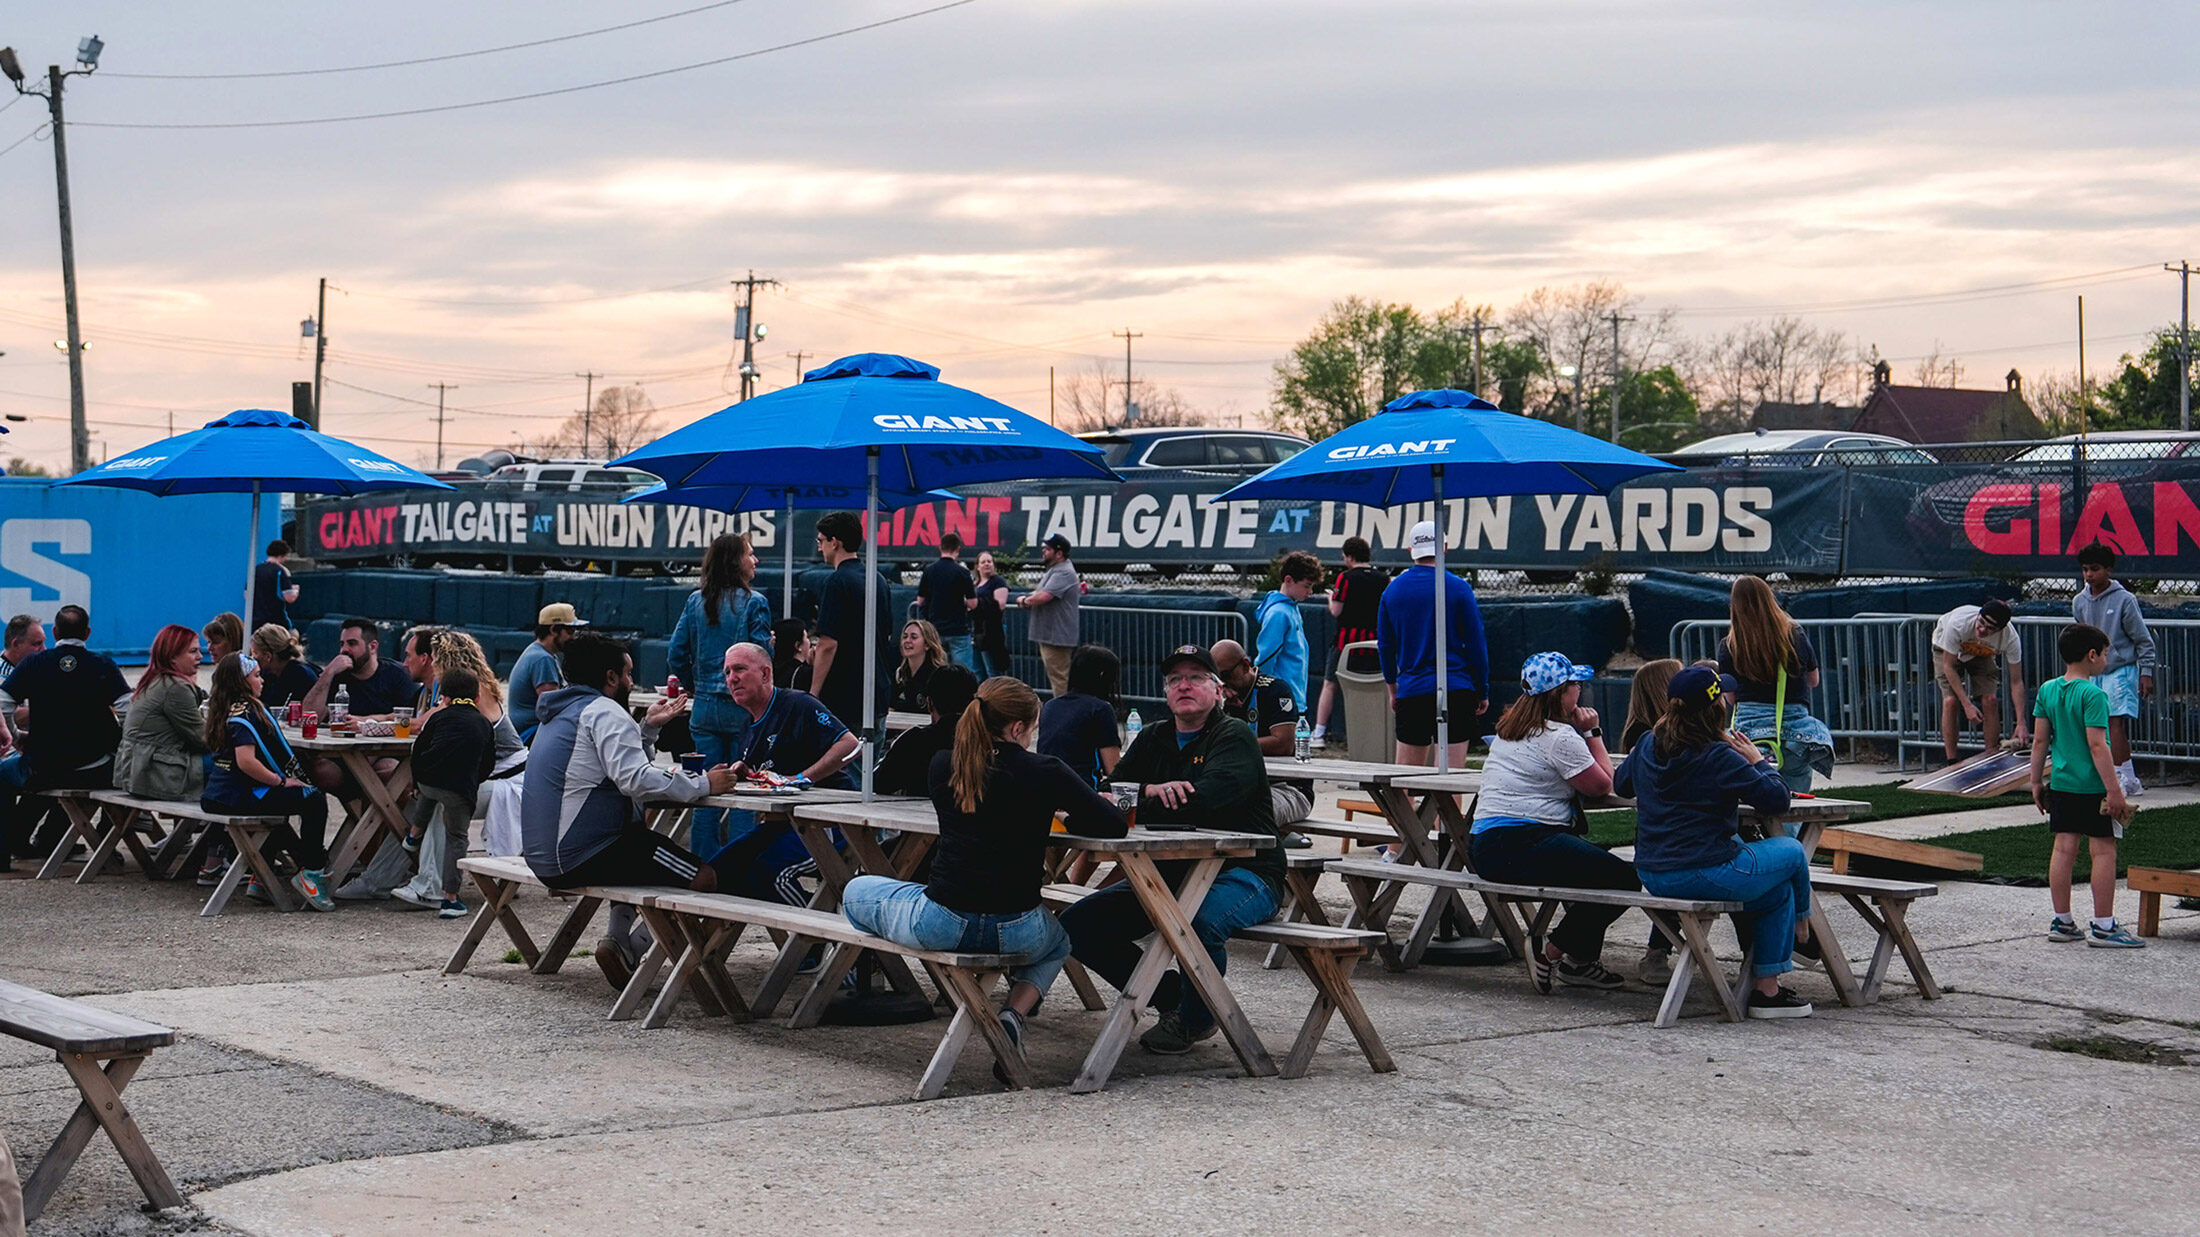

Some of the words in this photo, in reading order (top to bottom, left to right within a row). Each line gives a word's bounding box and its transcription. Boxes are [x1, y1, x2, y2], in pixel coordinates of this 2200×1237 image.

[873, 414, 1012, 431] GIANT
[1328, 439, 1457, 459] GIANT
[319, 505, 398, 549] GIANT
[401, 501, 528, 544] TAILGATE
[532, 515, 553, 533] AT
[557, 504, 655, 548] UNION
[1021, 494, 1260, 548] TAILGATE
[1268, 509, 1310, 533] AT
[1535, 487, 1773, 552] YARDS
